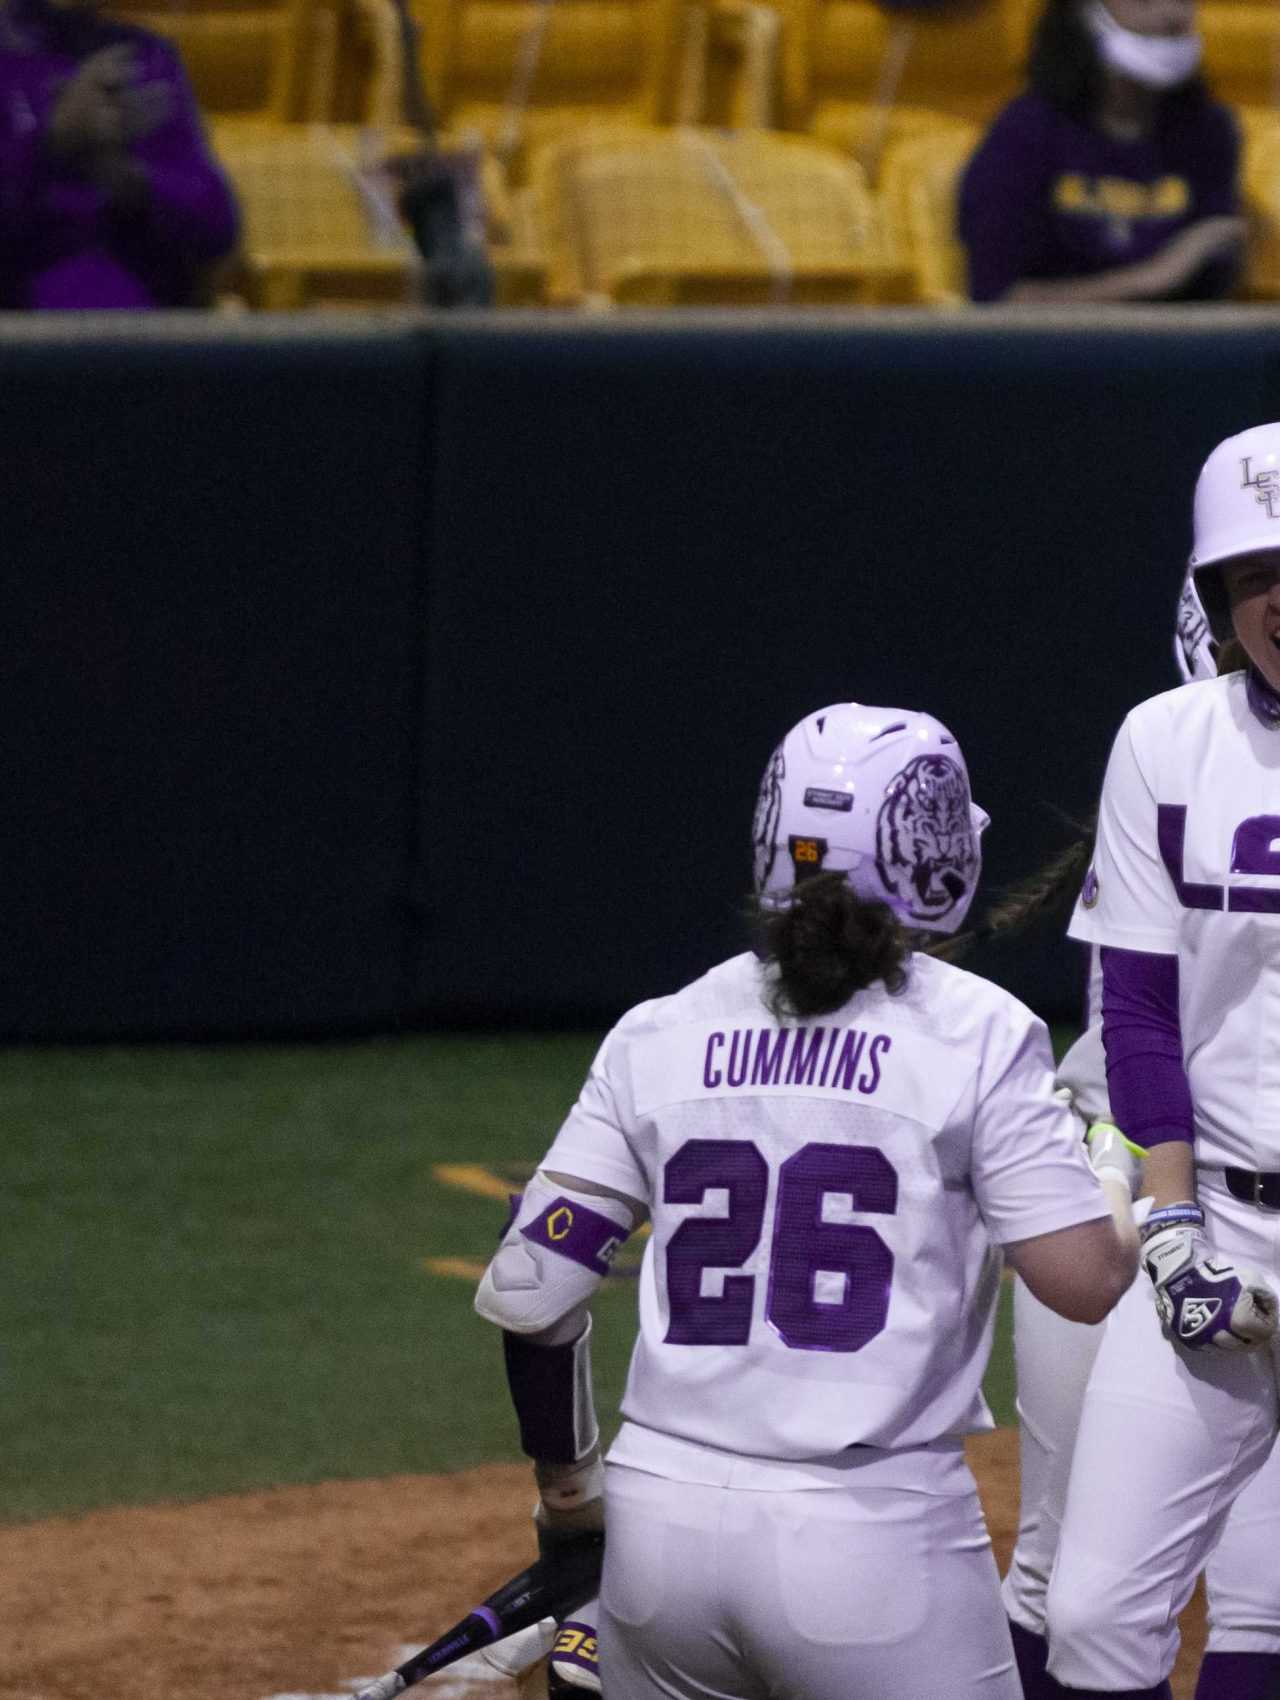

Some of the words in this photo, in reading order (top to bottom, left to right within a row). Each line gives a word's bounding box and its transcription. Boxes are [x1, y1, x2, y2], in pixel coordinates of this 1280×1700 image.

[795, 839, 818, 862] 26
[703, 1027, 892, 1094] CUMMINS
[663, 1139, 898, 1353] 26
